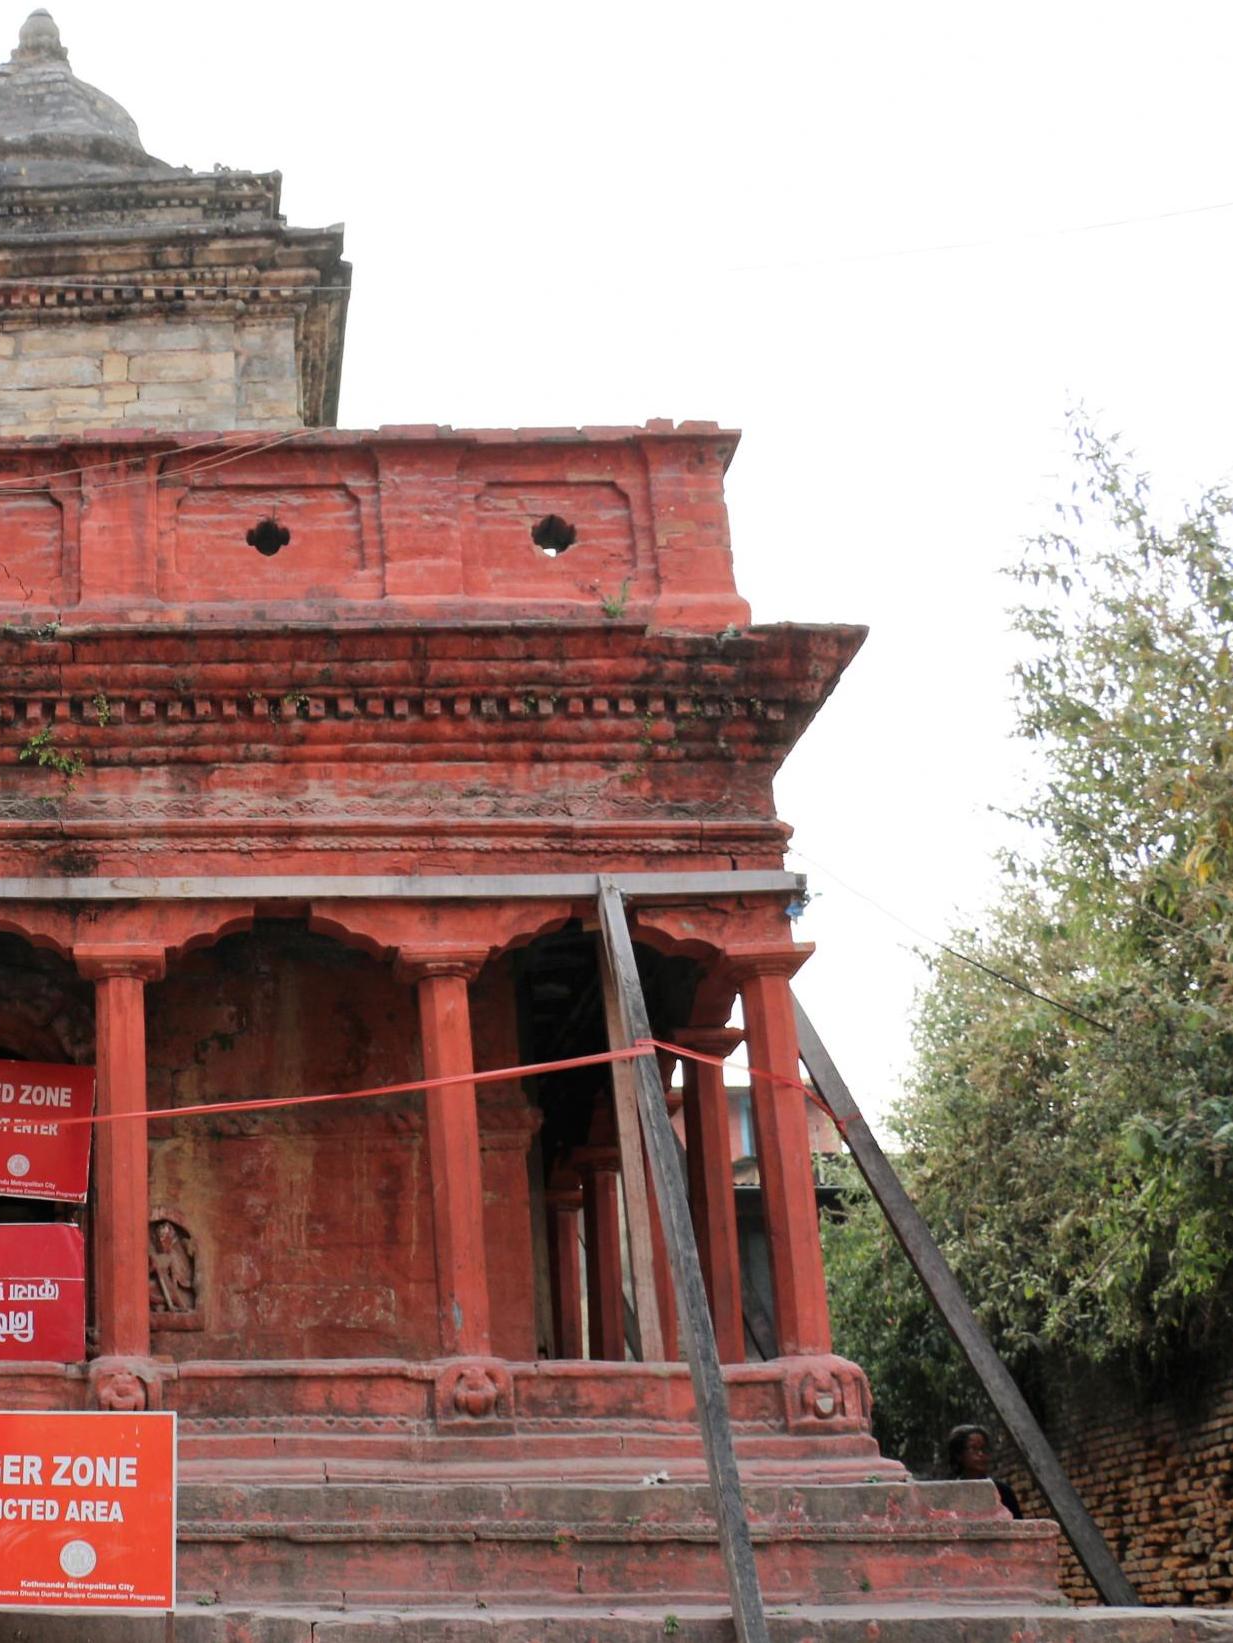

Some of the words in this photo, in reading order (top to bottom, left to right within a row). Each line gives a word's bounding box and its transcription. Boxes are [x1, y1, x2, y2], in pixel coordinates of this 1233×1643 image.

[19, 1085, 72, 1108] ZONE
[50, 1455, 138, 1488] ZONE
[64, 1500, 125, 1523] AREA
[20, 1579, 65, 1589] Kathmandu
[66, 1581, 117, 1592] Metropolitan
[118, 1583, 135, 1592] City
[86, 1592, 129, 1600] Conservation
